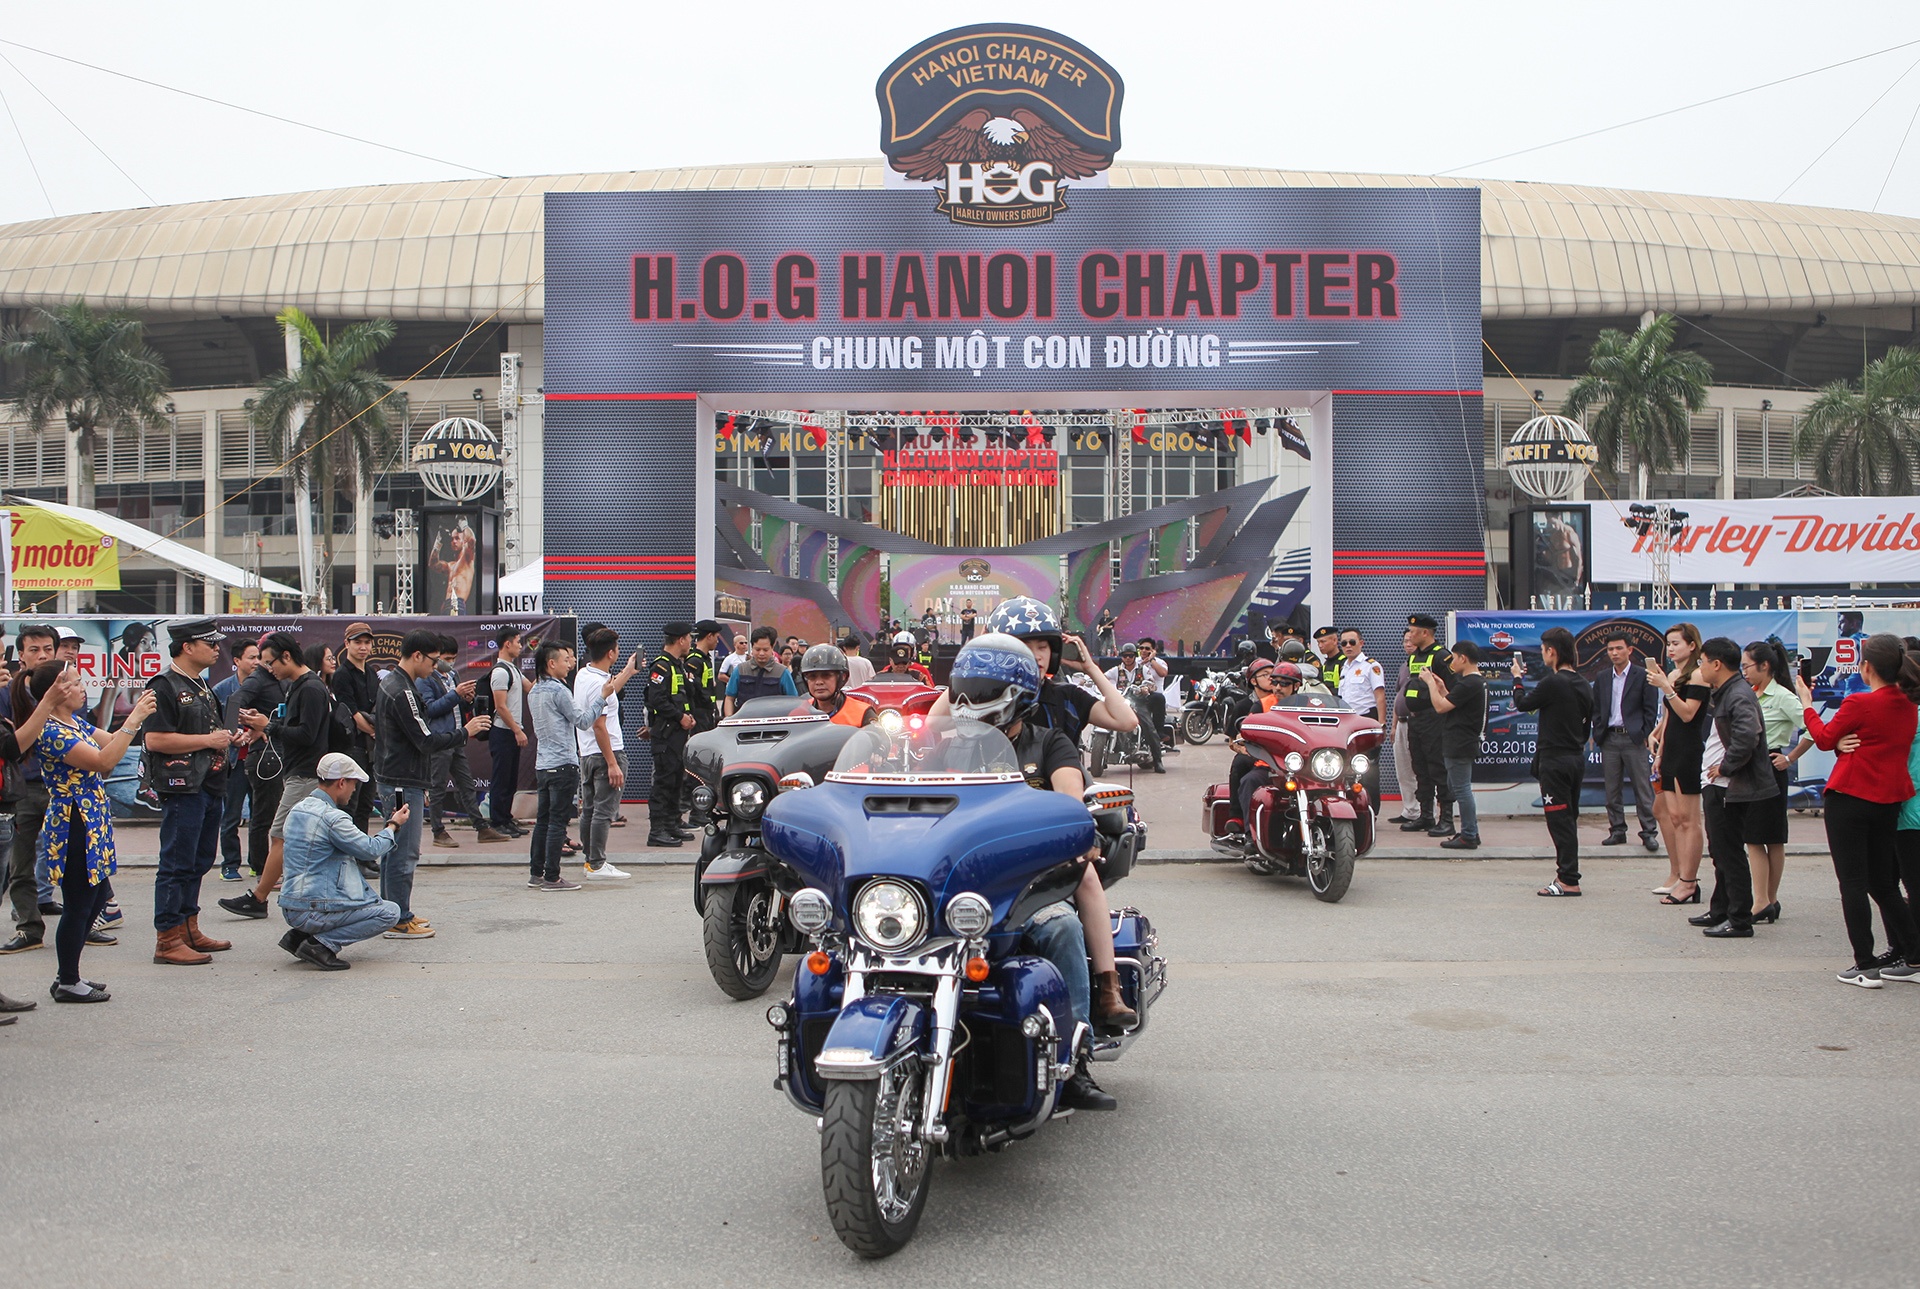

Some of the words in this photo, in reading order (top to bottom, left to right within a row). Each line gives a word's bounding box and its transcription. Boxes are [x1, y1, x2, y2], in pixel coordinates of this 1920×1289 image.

[911, 45, 980, 87] HANOI
[986, 42, 1089, 88] CHAPTER
[947, 63, 1049, 89] VIETNAM
[945, 161, 1056, 204] HOG
[956, 206, 985, 221] HARLEY
[986, 208, 1020, 221] OWNERS
[1021, 206, 1048, 220] GROUP
[633, 253, 817, 321] H.O.G
[841, 252, 1053, 320] HANOI
[1079, 252, 1399, 320] CHAPTER
[812, 336, 923, 369] CHUNG
[935, 329, 1010, 376] MỘT
[1023, 335, 1091, 369] CON
[1104, 327, 1220, 369] ĐƯỜNG
[715, 432, 758, 452] GYM
[780, 432, 868, 451] KICFIT
[449, 442, 496, 461] YOGA
[883, 450, 925, 468] H.O.G
[927, 450, 979, 468] HANOI
[982, 450, 1058, 469] CHAPTER
[1564, 444, 1599, 462] YOG
[884, 470, 935, 487] CHUNG
[970, 470, 1000, 487] CON
[12, 577, 94, 589] ngmotor.com
[498, 594, 538, 612] ARLEY
[221, 624, 236, 632] NHÀ
[237, 624, 247, 632] TÀI
[1584, 627, 1614, 645] HANOI
[1614, 625, 1655, 645] CHAPTER
[370, 646, 402, 657] ETNAM
[377, 637, 402, 648] CHAP
[77, 653, 162, 678] RING
[1837, 666, 1860, 674] FITN
[85, 679, 115, 688] YOGA
[118, 679, 146, 688] CENT
[1481, 740, 1537, 754] 03.2018
